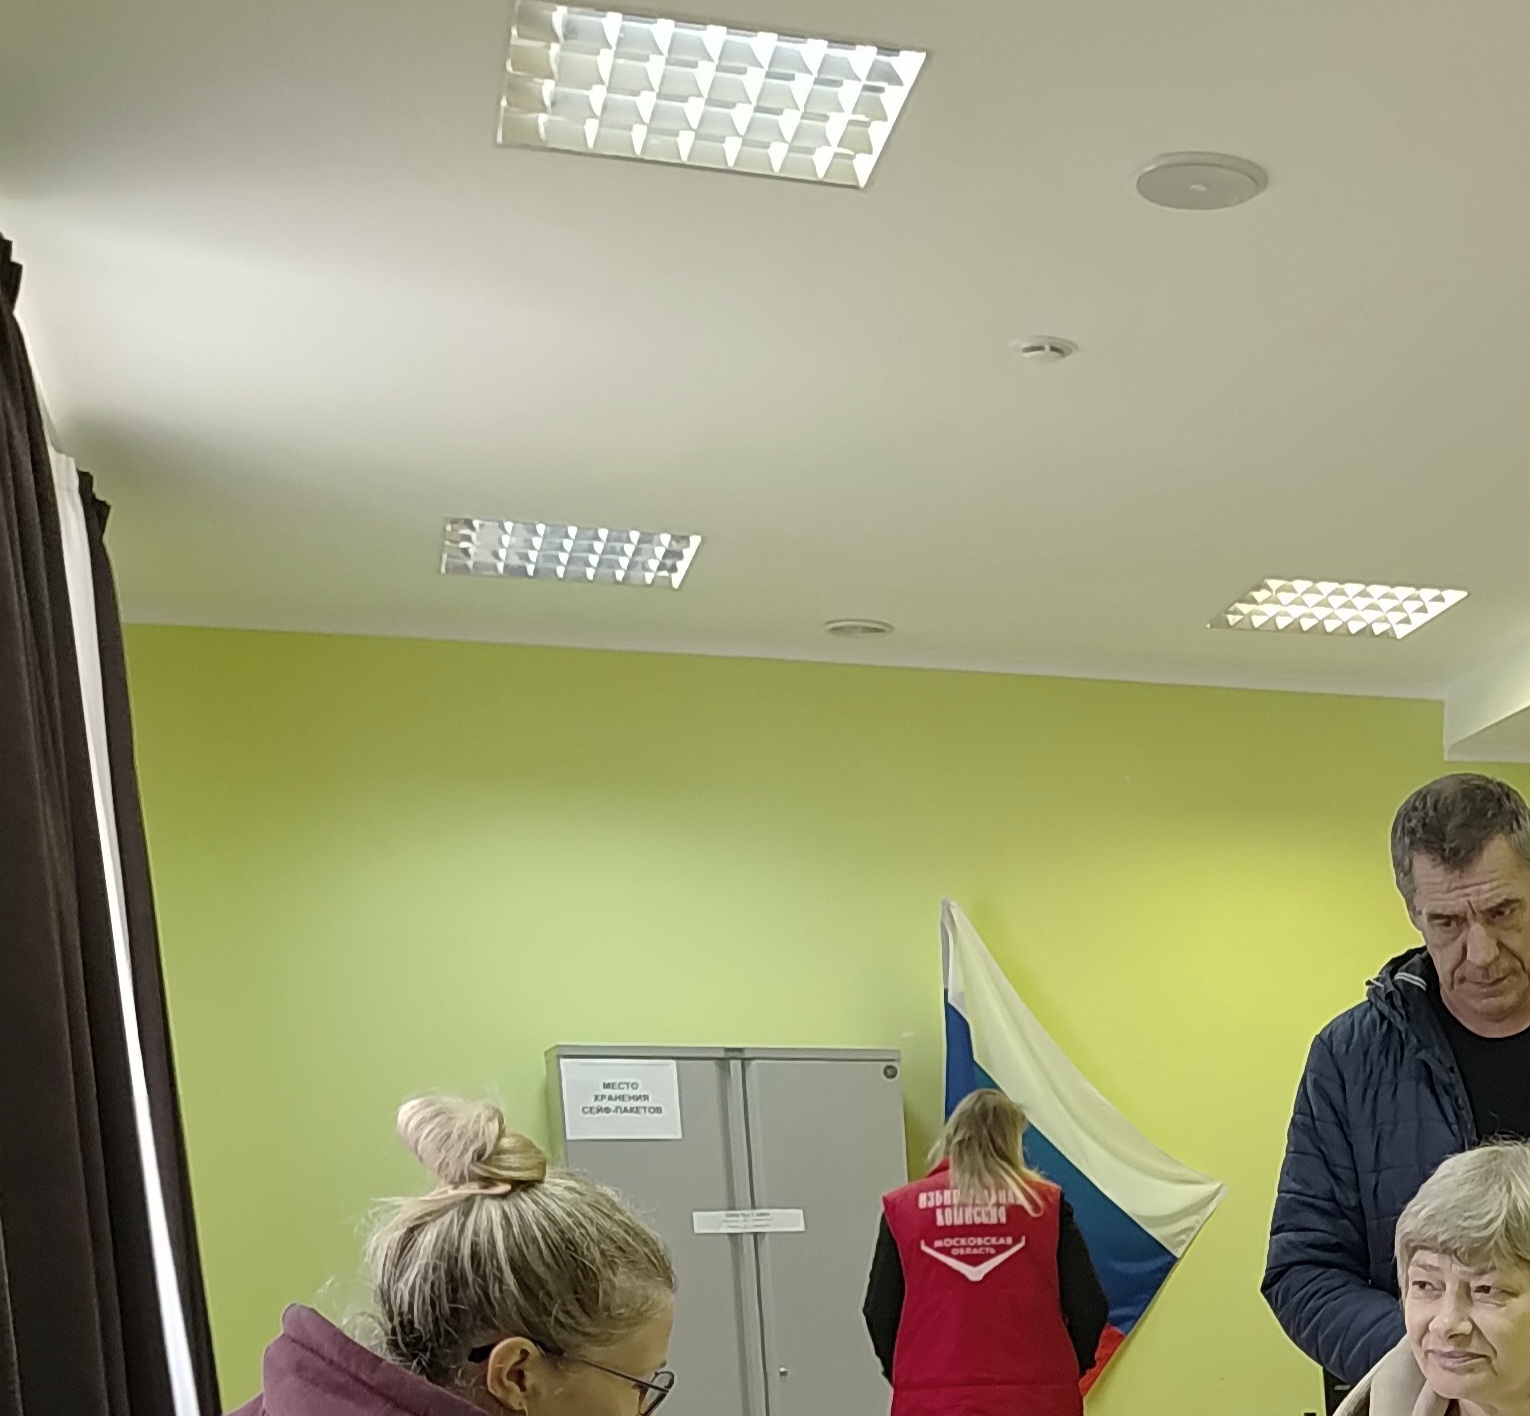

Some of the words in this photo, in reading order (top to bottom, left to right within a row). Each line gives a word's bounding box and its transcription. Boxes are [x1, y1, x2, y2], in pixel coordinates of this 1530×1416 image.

[602, 1081, 640, 1090] МЕСТО
[593, 1094, 650, 1102] ХРАНЕНИЯ
[581, 1105, 663, 1115] СЕЙФ-ПАКЕТОВ
[933, 1236, 1013, 1248] МОСКОВСКАЯ
[951, 1247, 996, 1256] ОБЛАСТЬ
